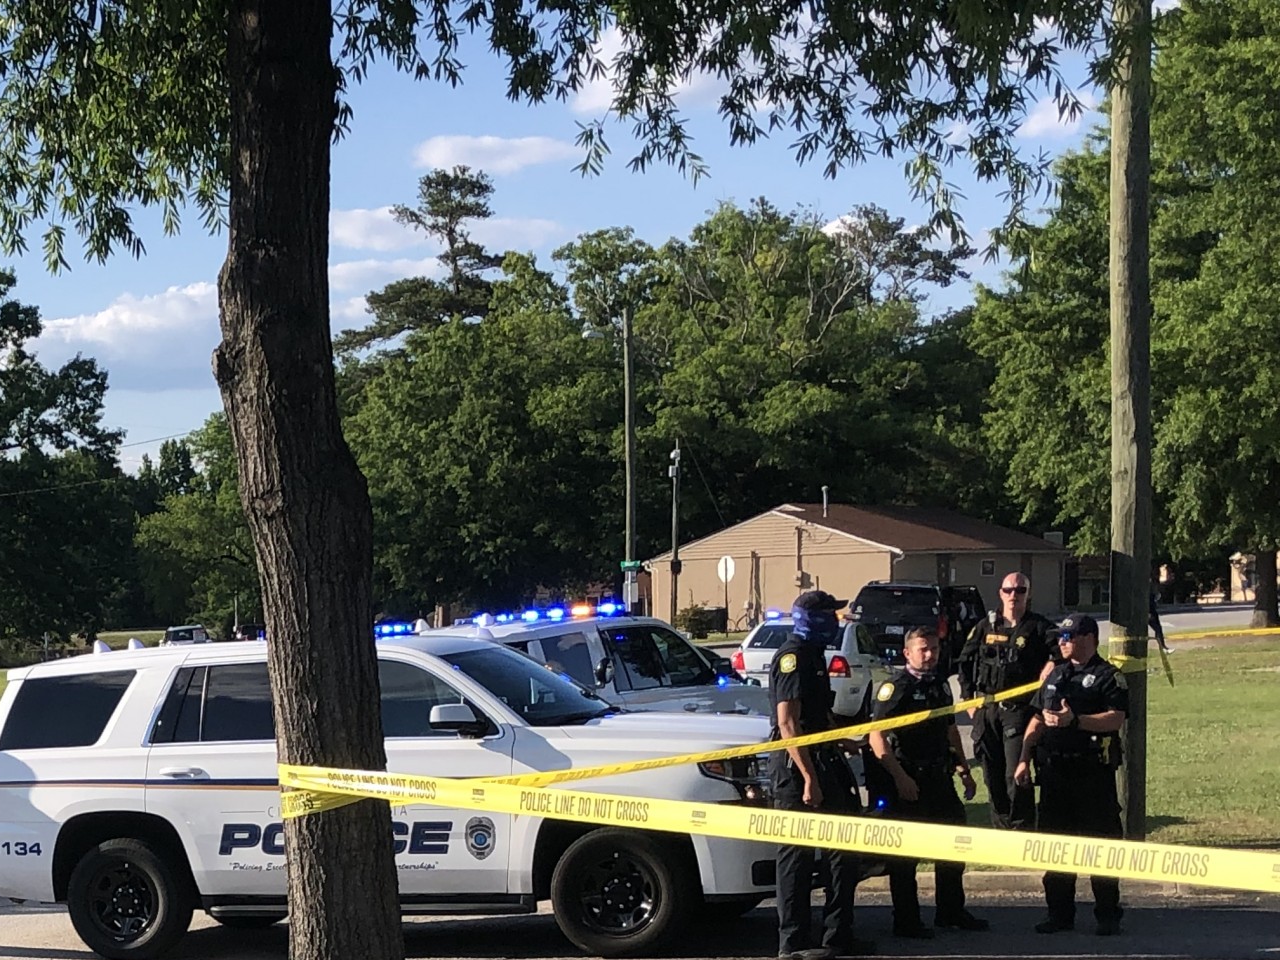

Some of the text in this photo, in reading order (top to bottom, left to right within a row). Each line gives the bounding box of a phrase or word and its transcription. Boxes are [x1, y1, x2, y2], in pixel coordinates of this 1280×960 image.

[519, 790, 650, 823] POLICE LINE DO NOT CROSS
[747, 813, 904, 849] POLICE LINE DO NOT CROSS
[1022, 839, 1210, 878] POLICE LINE DO NOT CROSS
